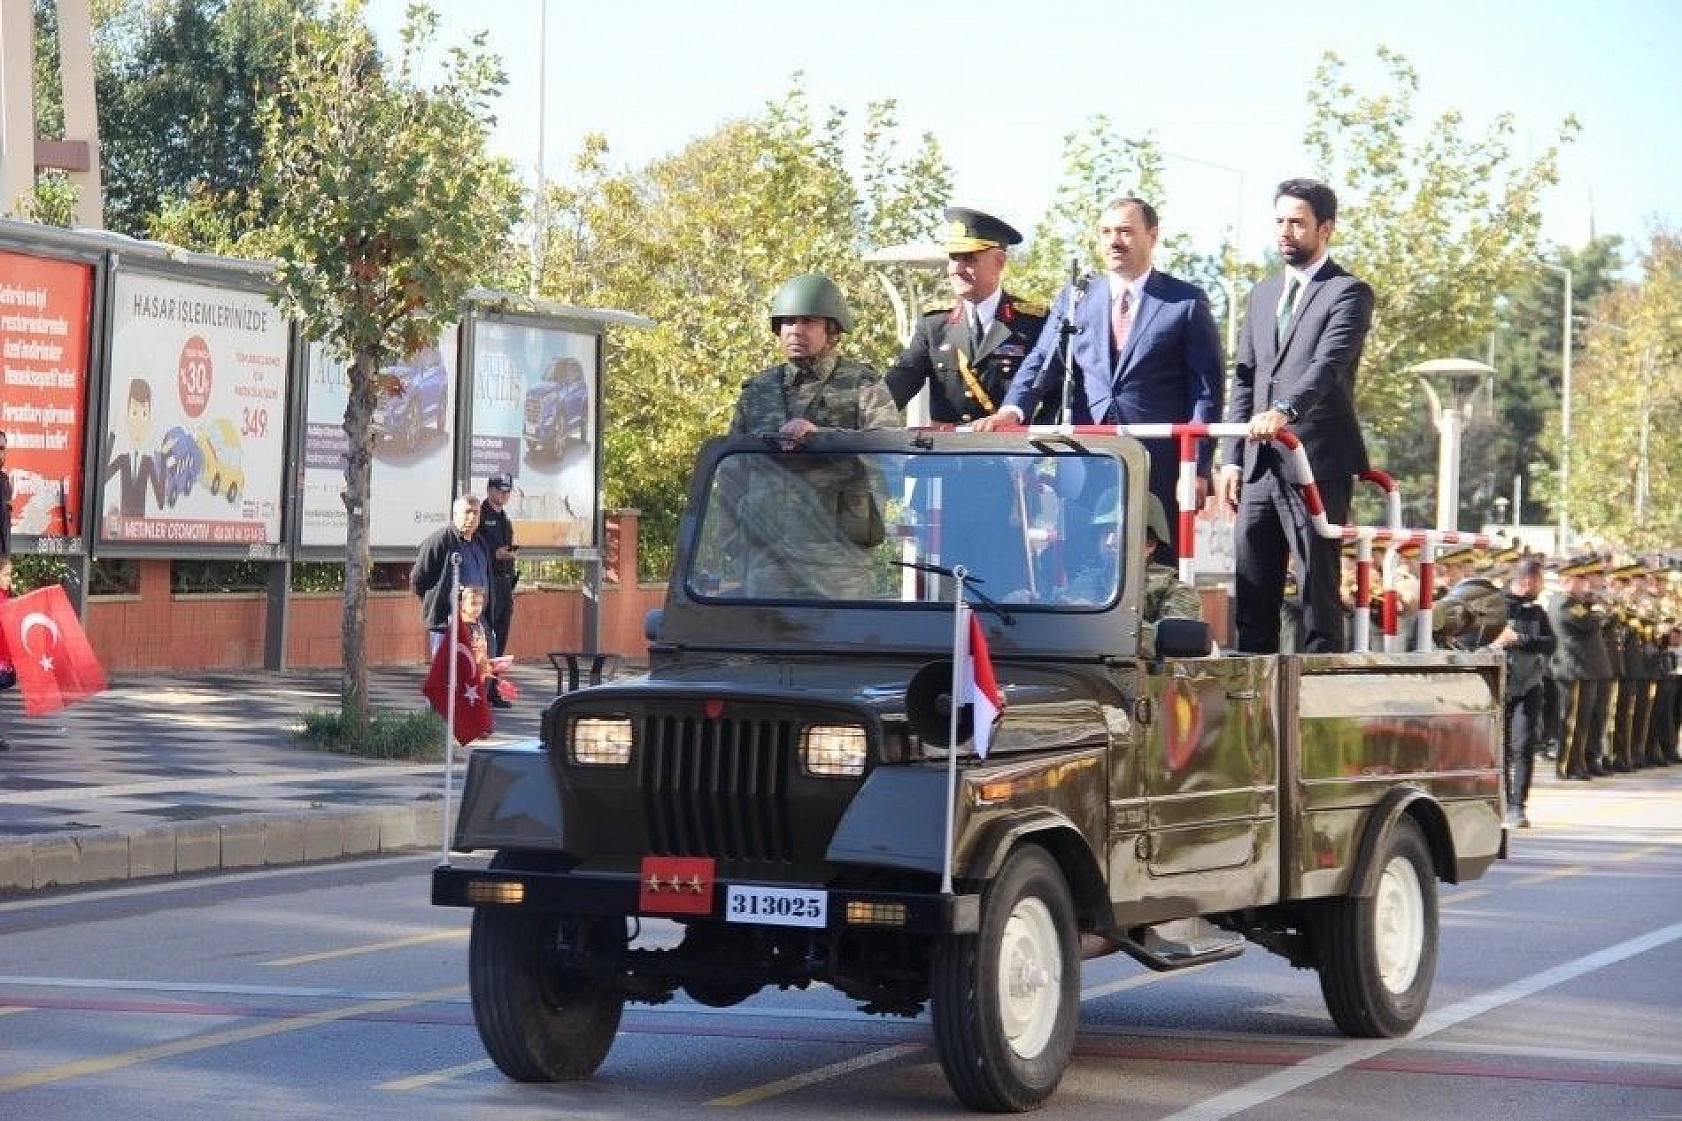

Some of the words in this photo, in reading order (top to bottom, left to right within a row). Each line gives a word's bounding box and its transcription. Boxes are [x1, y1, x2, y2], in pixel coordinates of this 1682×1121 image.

[134, 294, 175, 322] HASAR
[241, 408, 268, 438] 349
[733, 893, 820, 918] 313025
